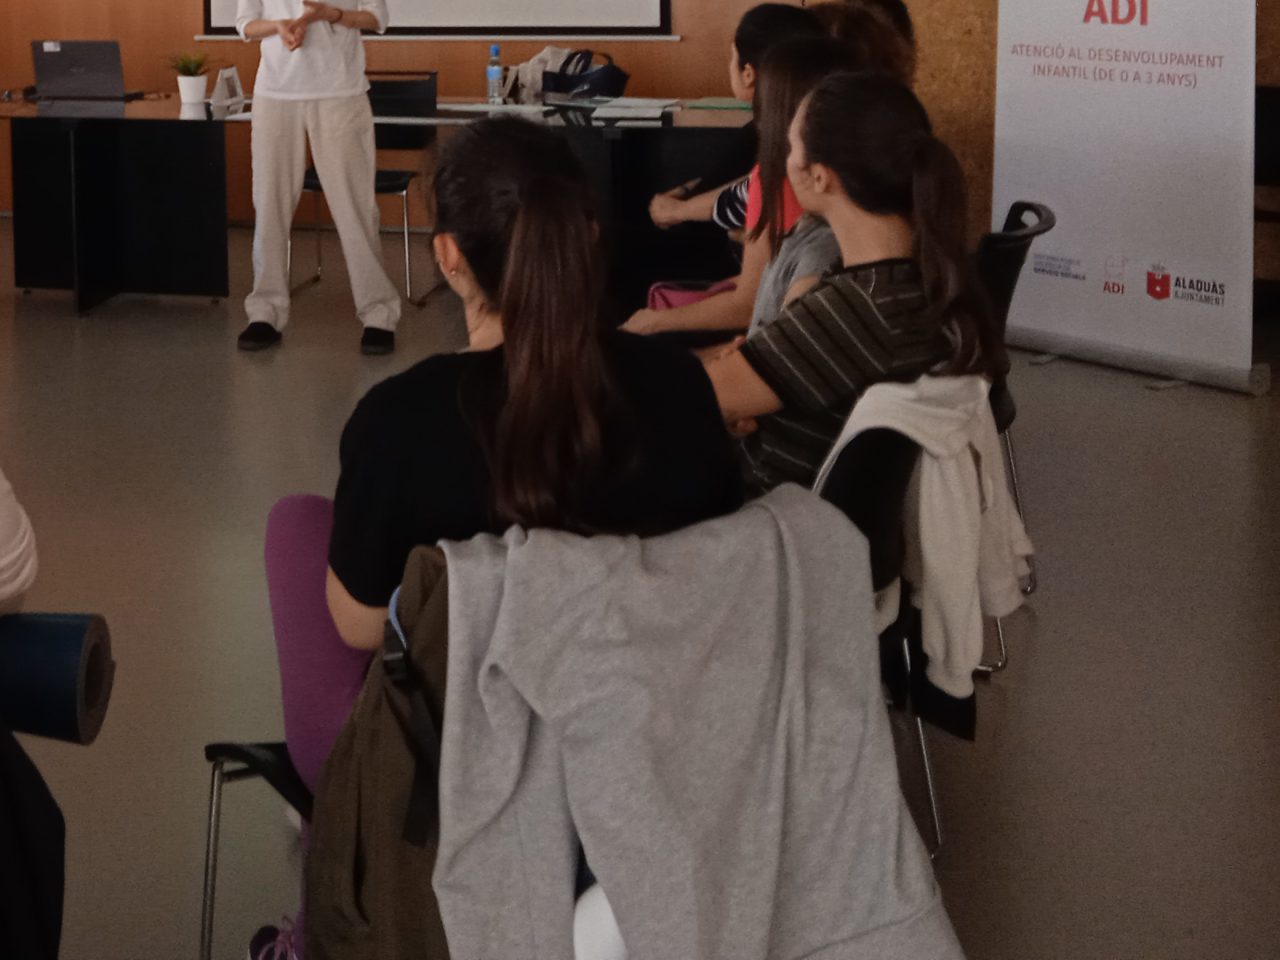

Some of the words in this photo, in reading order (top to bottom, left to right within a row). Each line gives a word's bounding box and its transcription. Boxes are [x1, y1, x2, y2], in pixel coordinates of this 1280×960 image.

[1011, 43, 1064, 59] ATENCIÓ
[1068, 47, 1083, 60] AL
[1088, 47, 1224, 69] DESENVOLUPAMENT
[1032, 63, 1089, 81] INFANTIL
[1092, 65, 1115, 82] (DE
[1132, 69, 1142, 84] A
[1146, 71, 1153, 85] 3
[1156, 72, 1198, 89] ANYS)
[1103, 280, 1126, 296] ADI
